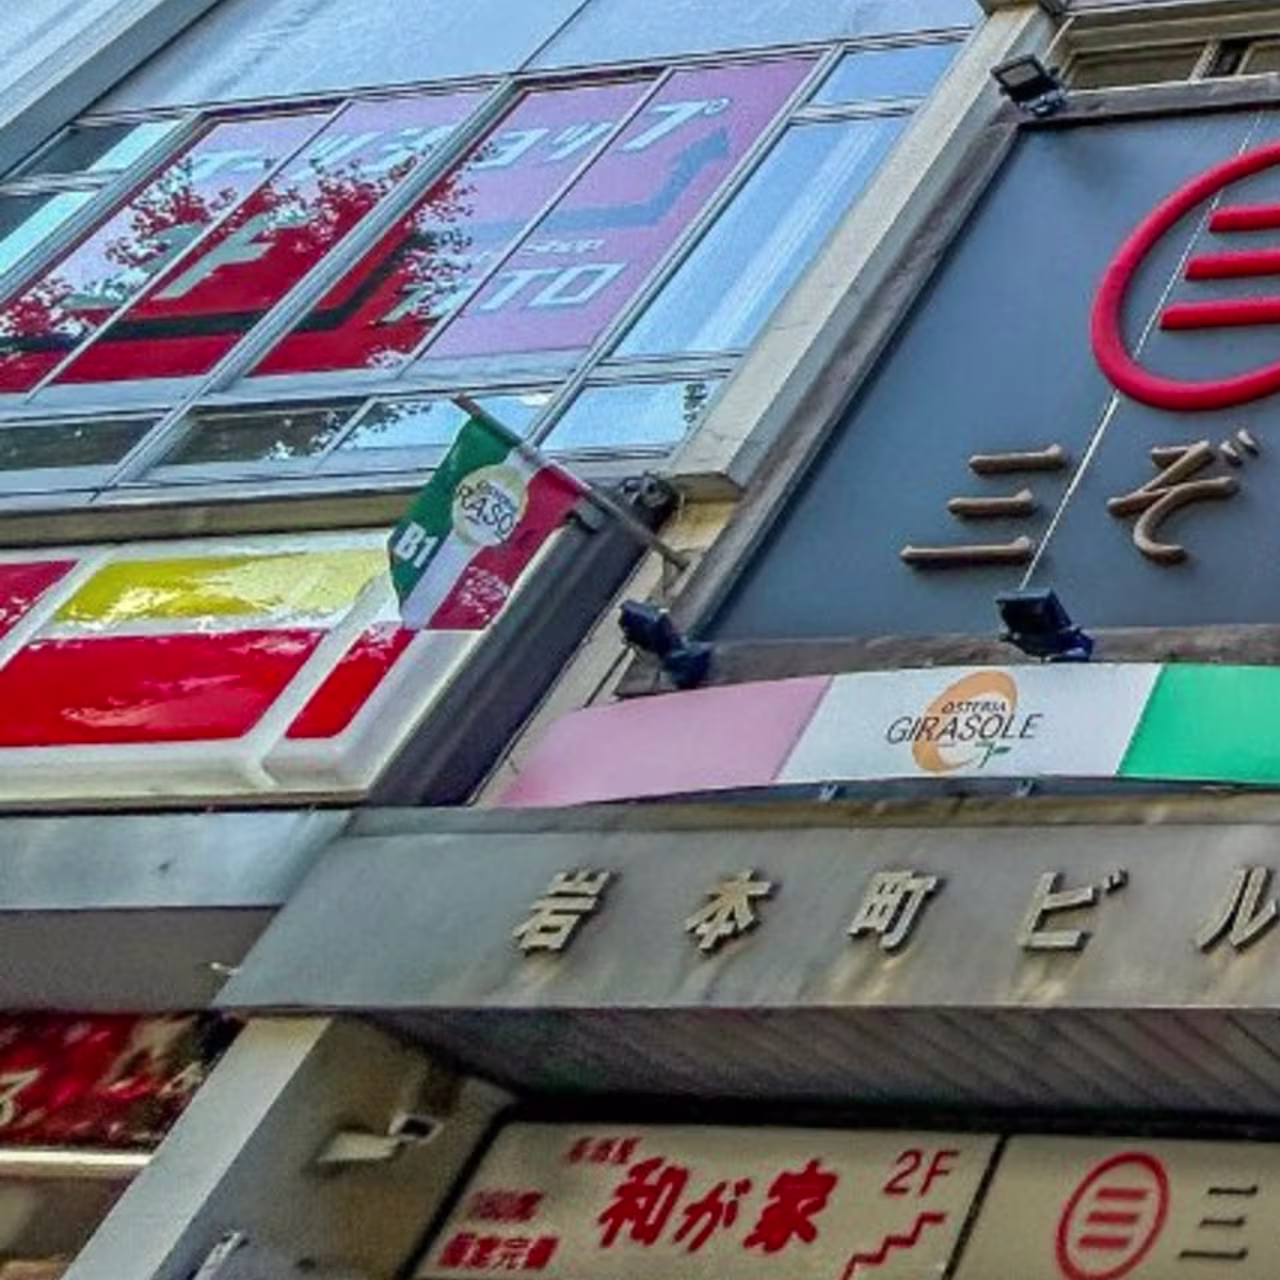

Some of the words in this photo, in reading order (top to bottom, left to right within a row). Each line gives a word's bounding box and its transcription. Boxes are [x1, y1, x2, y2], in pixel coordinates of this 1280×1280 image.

[393, 521, 439, 569] B1
[885, 713, 1044, 745] GIRASOLE
[884, 1149, 960, 1197] 2F
[597, 1156, 839, 1253] 和が家
